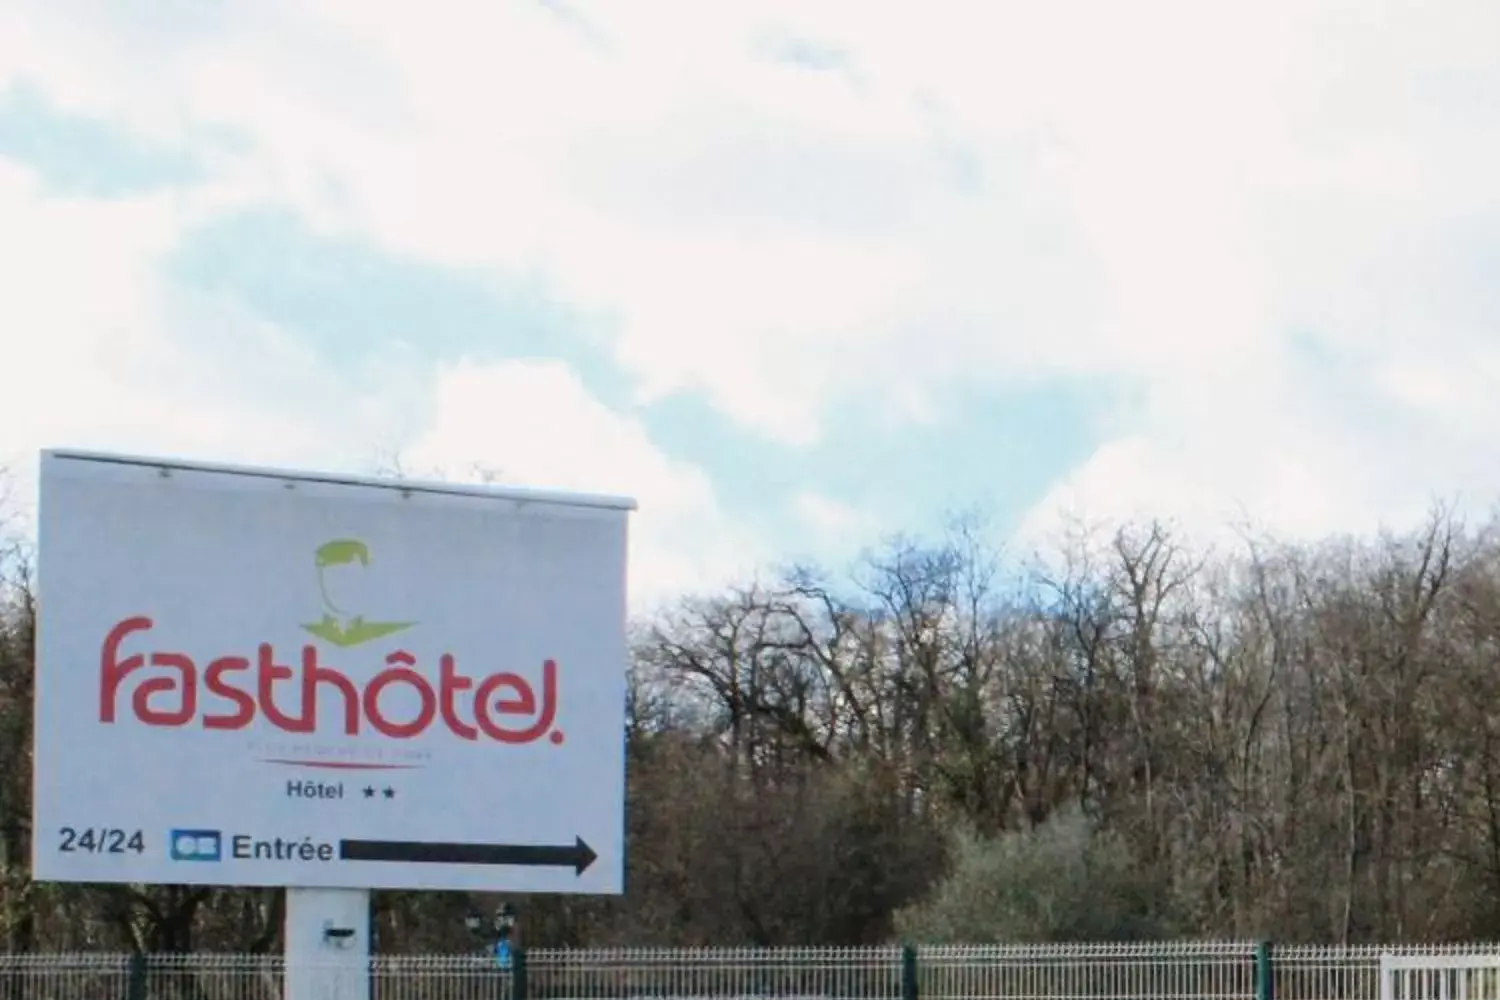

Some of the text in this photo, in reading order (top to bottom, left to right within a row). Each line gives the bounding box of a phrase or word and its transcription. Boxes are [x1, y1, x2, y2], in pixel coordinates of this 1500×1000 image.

[286, 780, 343, 801] Hôtel
[58, 828, 145, 854] 24/24
[232, 836, 333, 861] Entrée
